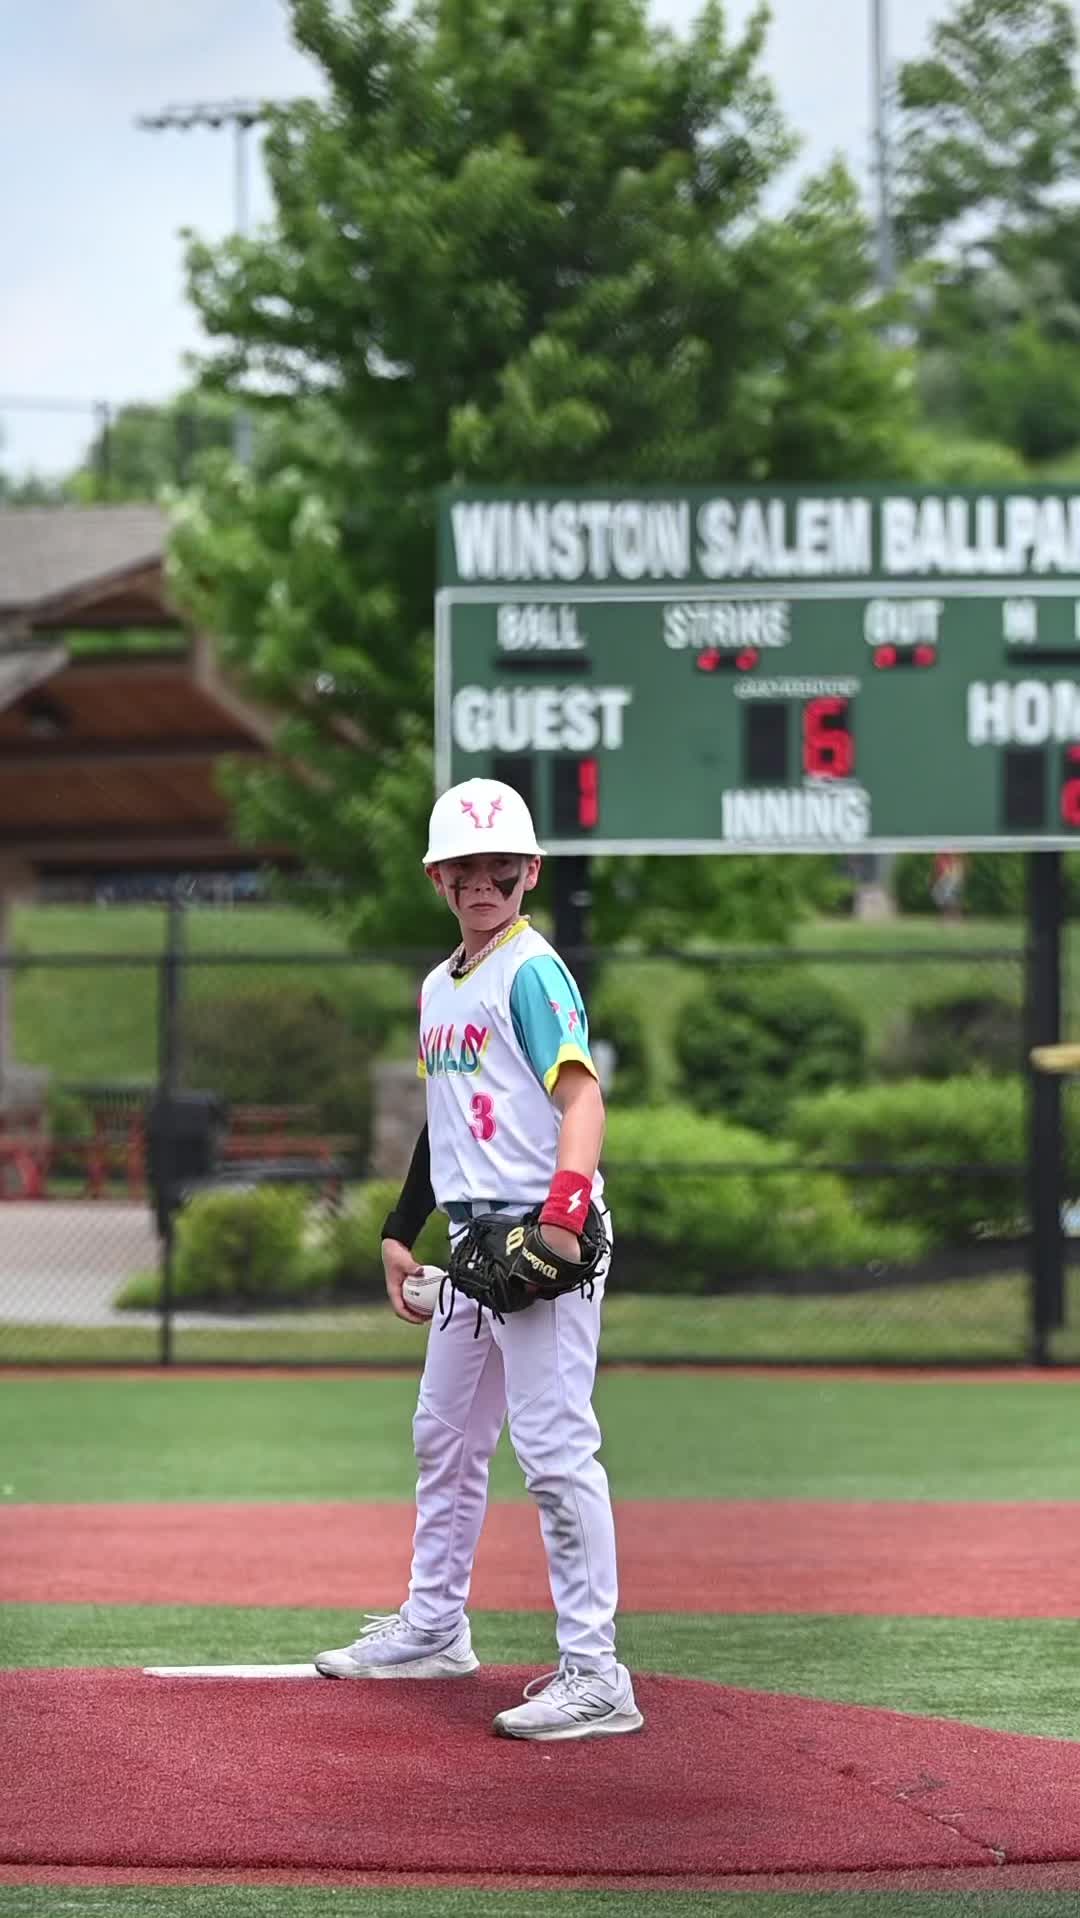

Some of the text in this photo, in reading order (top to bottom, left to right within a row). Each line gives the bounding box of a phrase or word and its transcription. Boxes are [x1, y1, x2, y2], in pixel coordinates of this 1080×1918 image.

[452, 501, 690, 579] WINSTON
[697, 498, 871, 578] SALEM
[498, 604, 586, 650] BALL
[663, 602, 790, 649] STRIKE
[864, 599, 944, 645] OUT
[453, 684, 632, 751] GUEST
[803, 695, 855, 779] 6
[470, 1092, 496, 1142] 3
